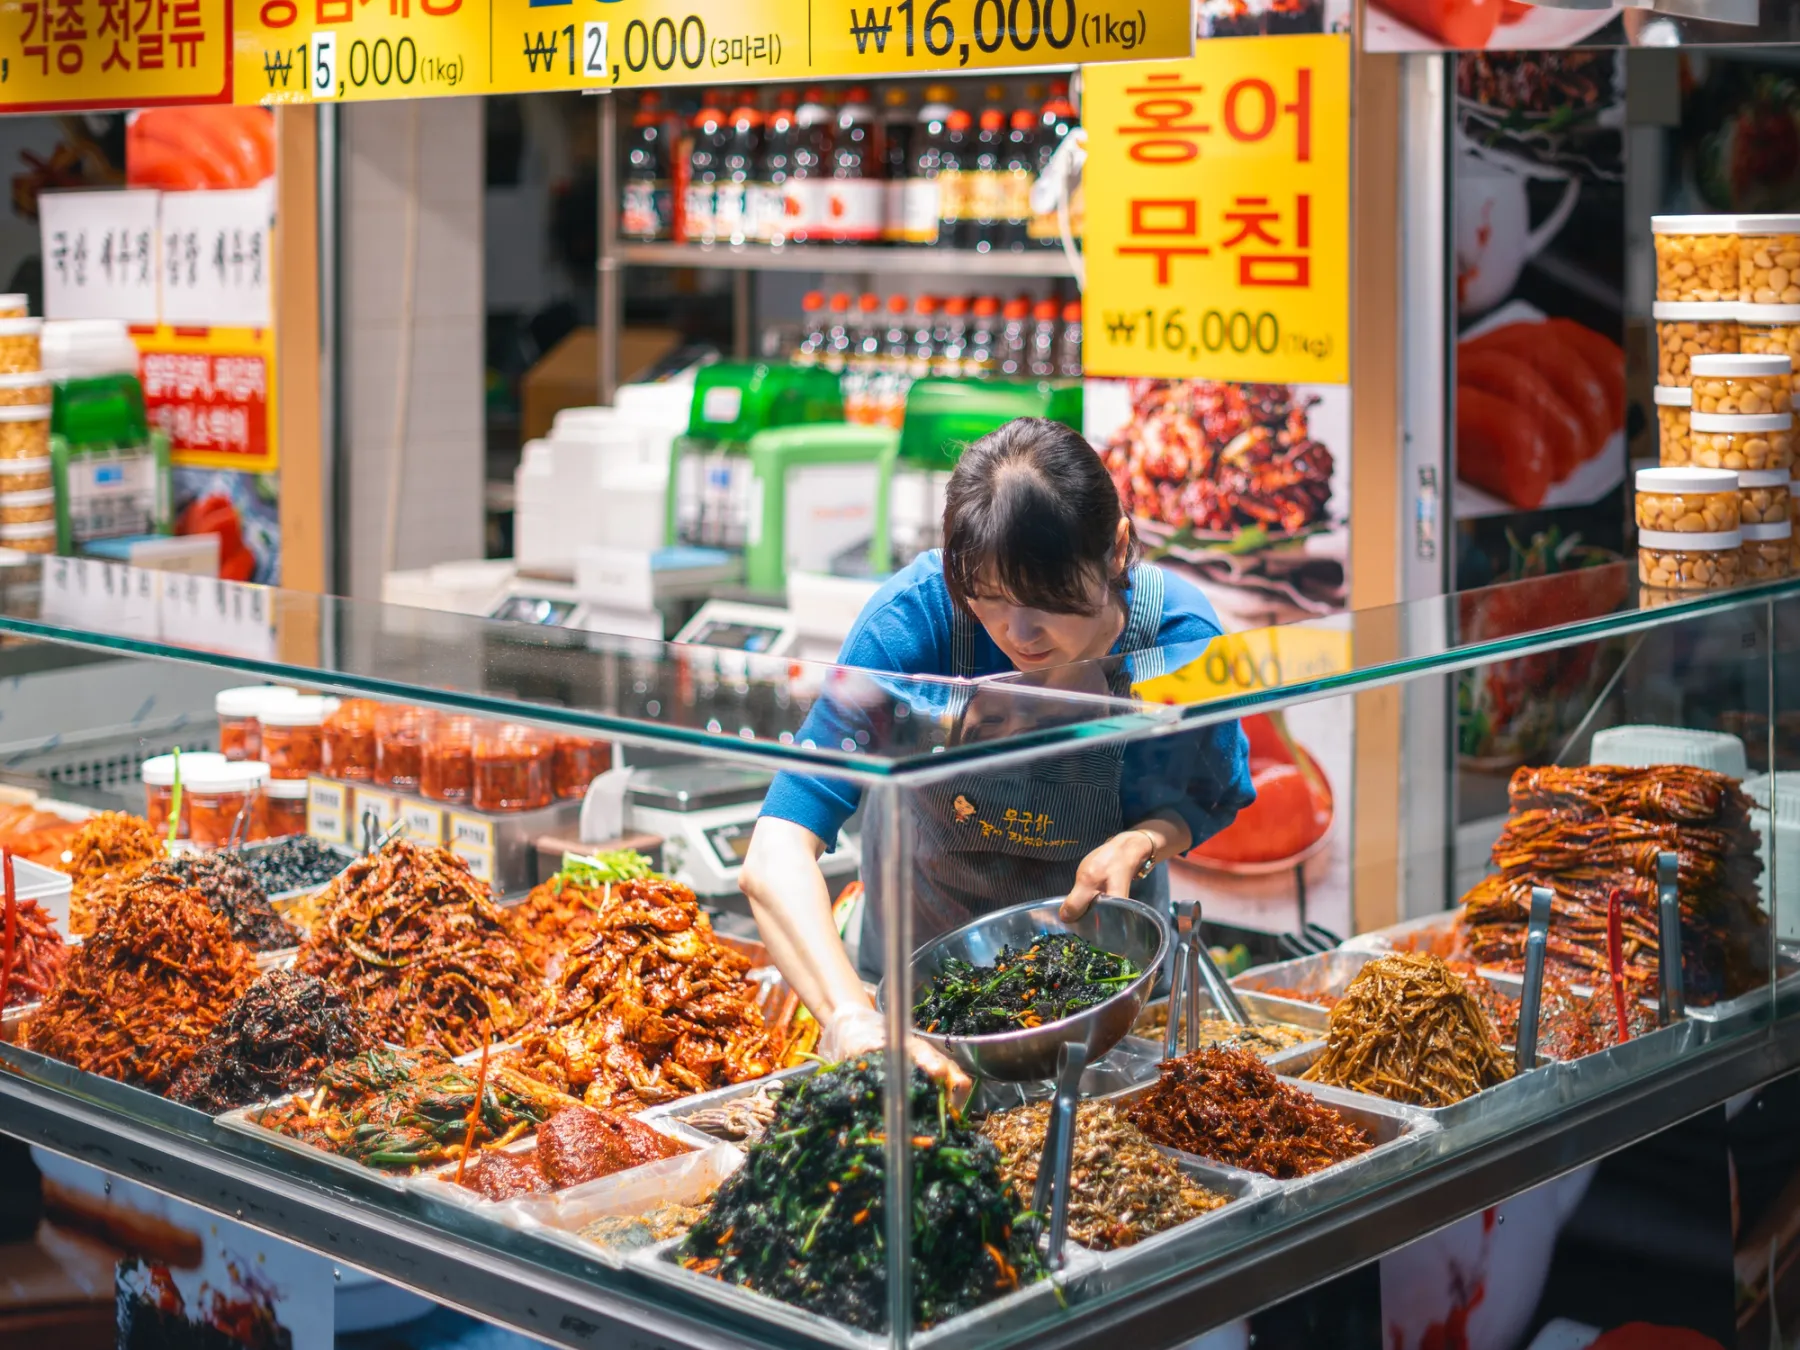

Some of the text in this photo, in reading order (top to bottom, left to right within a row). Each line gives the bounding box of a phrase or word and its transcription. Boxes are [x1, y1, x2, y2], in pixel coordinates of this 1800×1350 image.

[20, 0, 205, 76] 각종 젓갈류
[1118, 67, 1311, 165] 홍어
[1118, 194, 1310, 287] 무침
